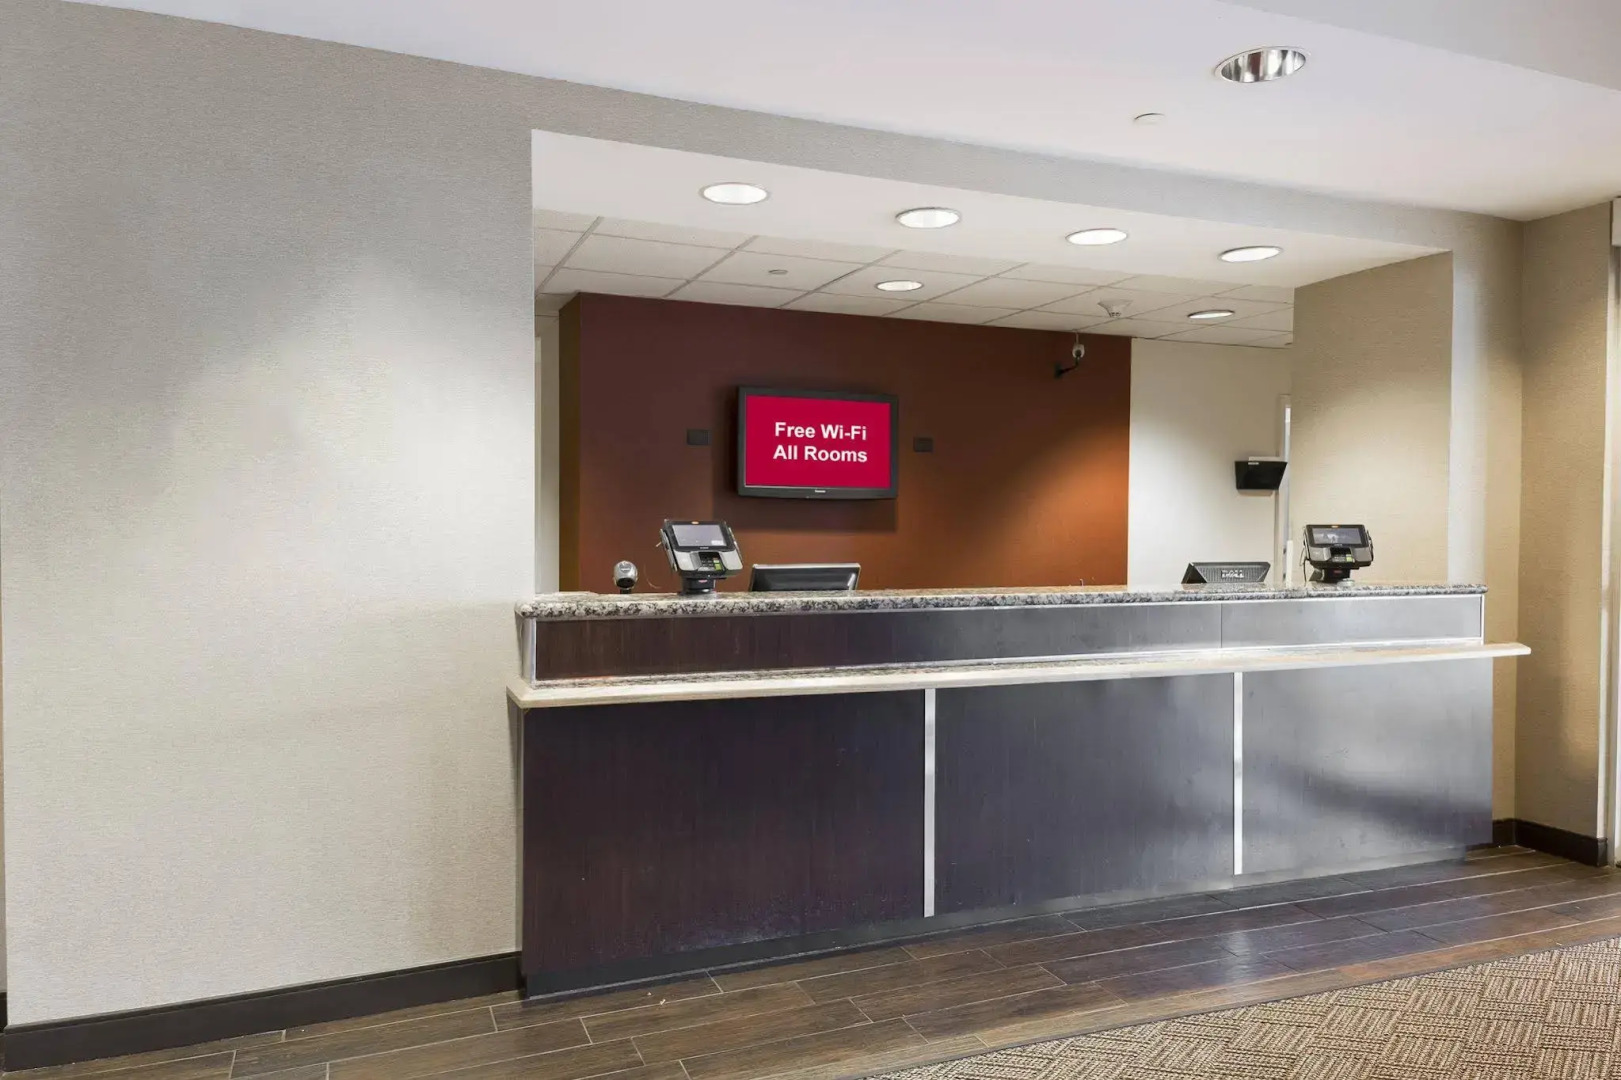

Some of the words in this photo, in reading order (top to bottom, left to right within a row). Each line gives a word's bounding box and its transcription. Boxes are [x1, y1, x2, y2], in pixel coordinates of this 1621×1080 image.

[774, 422, 816, 438] Free
[820, 424, 868, 441] Wi-Fi
[773, 444, 798, 460] All
[804, 446, 868, 463] Rooms
